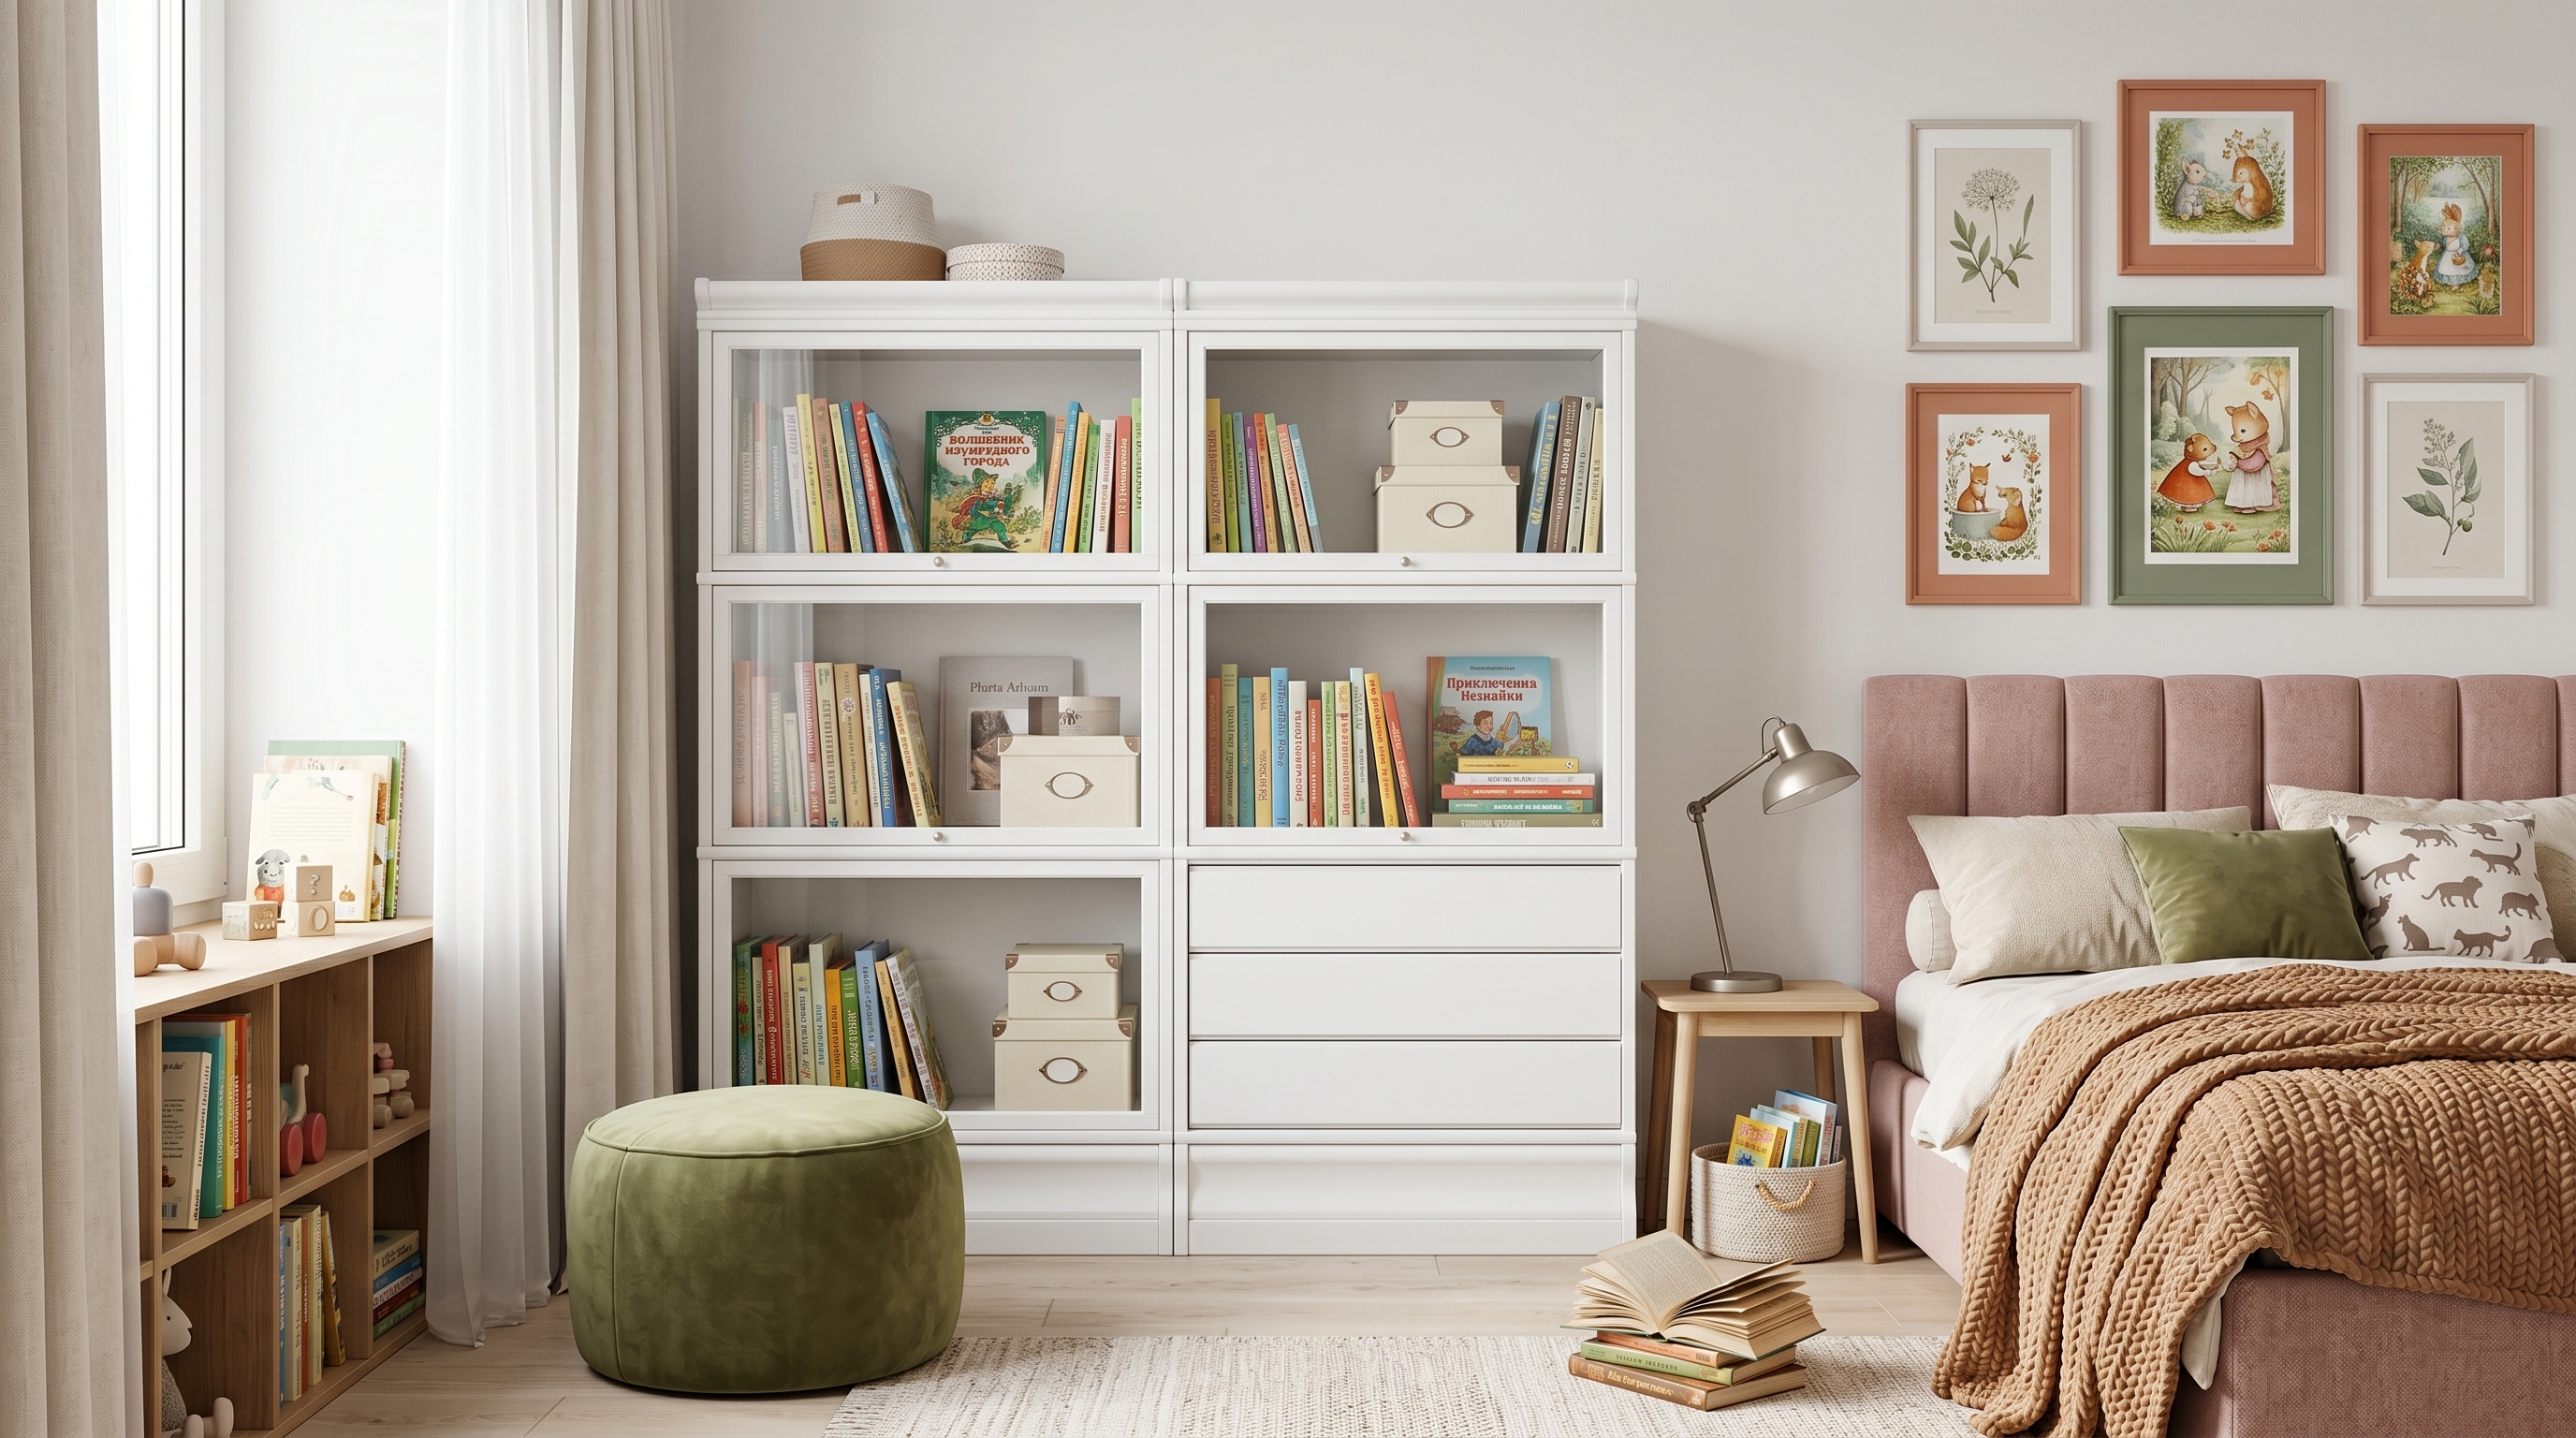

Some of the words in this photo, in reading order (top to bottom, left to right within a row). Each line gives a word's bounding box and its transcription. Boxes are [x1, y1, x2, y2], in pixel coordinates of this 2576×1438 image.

[949, 435, 1025, 445] ВОЛШЕБНИК
[944, 447, 1031, 457] ИЗУМРУДНОГО
[963, 458, 1010, 467] ГОРОДА
